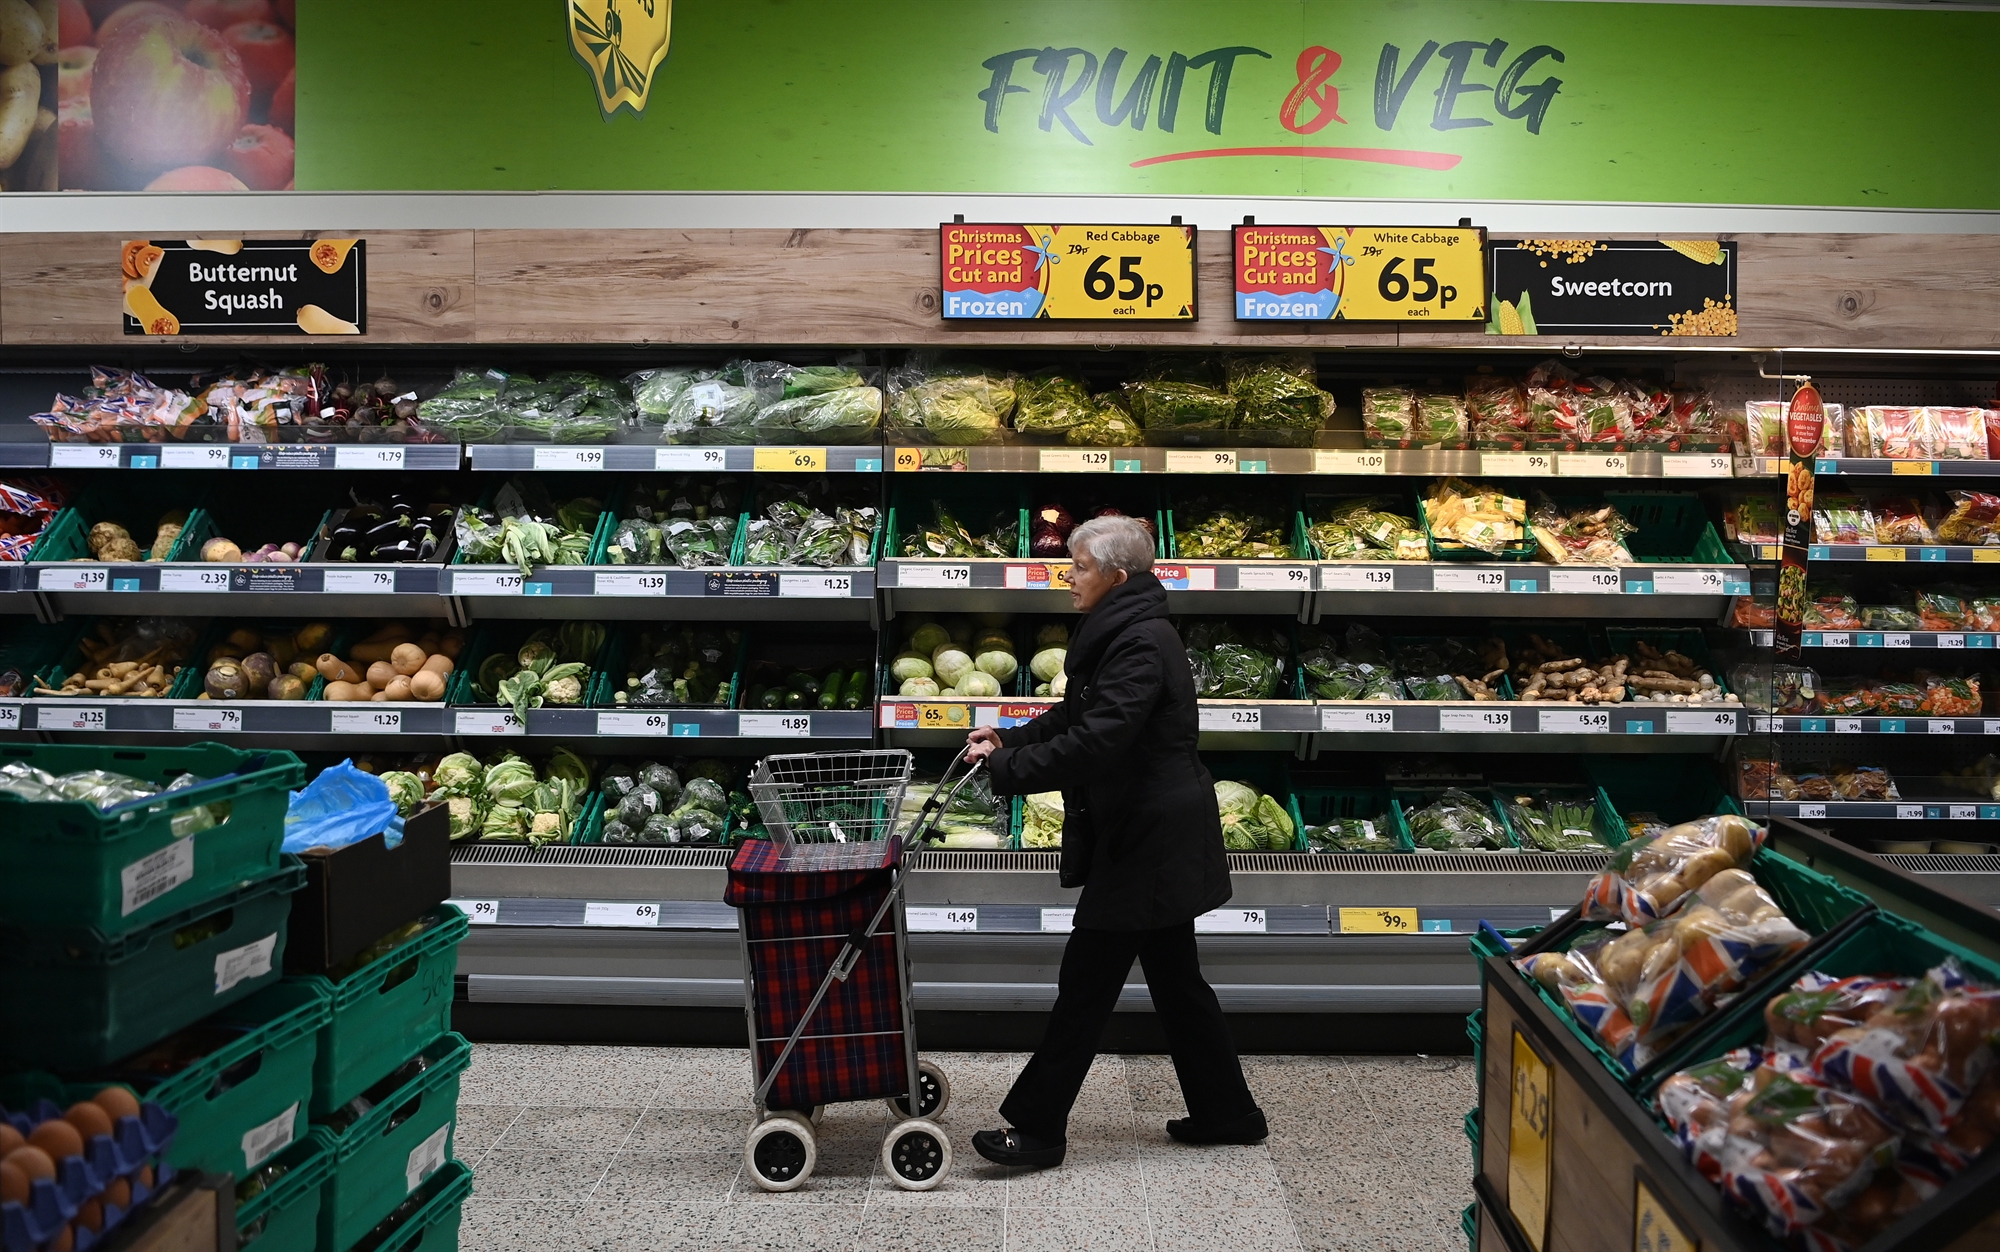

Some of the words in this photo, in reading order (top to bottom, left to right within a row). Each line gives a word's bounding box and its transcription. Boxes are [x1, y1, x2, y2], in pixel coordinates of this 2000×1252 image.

[978, 46, 1271, 146] FRUIT
[1279, 45, 1348, 135] &
[1374, 38, 1565, 136] VEG
[949, 230, 1022, 244] Christmas
[1086, 232, 1108, 242] Red
[1112, 231, 1160, 245] Cabbage
[1244, 232, 1316, 246] Christmas
[1374, 233, 1408, 244] White
[1412, 233, 1460, 246] Cabbage
[949, 244, 1022, 266] Prices
[1244, 246, 1316, 267] Prices
[190, 262, 298, 282] Butternut
[949, 266, 984, 283] Cut
[987, 266, 1022, 283] and
[1244, 268, 1277, 284] Cut
[1282, 268, 1316, 284] and
[1084, 254, 1164, 308] 65p
[1378, 256, 1458, 310] 65p
[1551, 276, 1672, 297] Sweetcorn
[204, 288, 283, 315] Squash
[950, 298, 1022, 316] Frozen
[1112, 306, 1136, 315] each
[1244, 299, 1318, 317] Frozen
[1408, 307, 1430, 316] each
[1790, 412, 1822, 422] VEGETABLES
[99, 449, 117, 460] 99p
[208, 450, 226, 462] 99p
[378, 452, 402, 462] £1.79
[576, 452, 601, 462] £1.99
[704, 452, 723, 464] 99p
[898, 455, 916, 466] 69p
[1082, 454, 1107, 464] £1.29
[1214, 454, 1234, 466] 99p
[794, 455, 816, 468] 69p
[1357, 456, 1382, 467] £1.09
[1528, 457, 1548, 469] 99p
[1606, 458, 1625, 469] 69p
[1710, 458, 1728, 470] 59p
[80, 572, 105, 583] £1.39
[200, 574, 227, 584] £2.39
[374, 574, 392, 586] 79p
[942, 569, 968, 580] £1.79
[1288, 570, 1308, 582] 99p
[1366, 572, 1391, 583] £1.39
[1477, 574, 1502, 584] £1.29
[1592, 574, 1618, 586] £1.09
[496, 576, 521, 587] £1.79
[638, 578, 664, 588] £1.39
[824, 579, 850, 590] £1.25
[1702, 575, 1722, 587] 99p
[80, 712, 104, 723] £1.25
[221, 712, 240, 723] 79p
[374, 715, 399, 726] £1.29
[504, 715, 520, 727] 99
[925, 709, 943, 721] 65p
[1232, 712, 1258, 723] £2.25
[1366, 713, 1391, 724] £1.39
[1484, 714, 1509, 724] £1.39
[1580, 714, 1607, 726] £5.49
[1714, 714, 1734, 726] 49p
[646, 716, 666, 728] 69p
[782, 718, 808, 730] £1.89
[475, 903, 495, 916] 99p
[636, 906, 656, 918] 69p
[947, 912, 974, 924] £1.49
[1243, 912, 1264, 924] 79p
[1384, 916, 1407, 929] 99p
